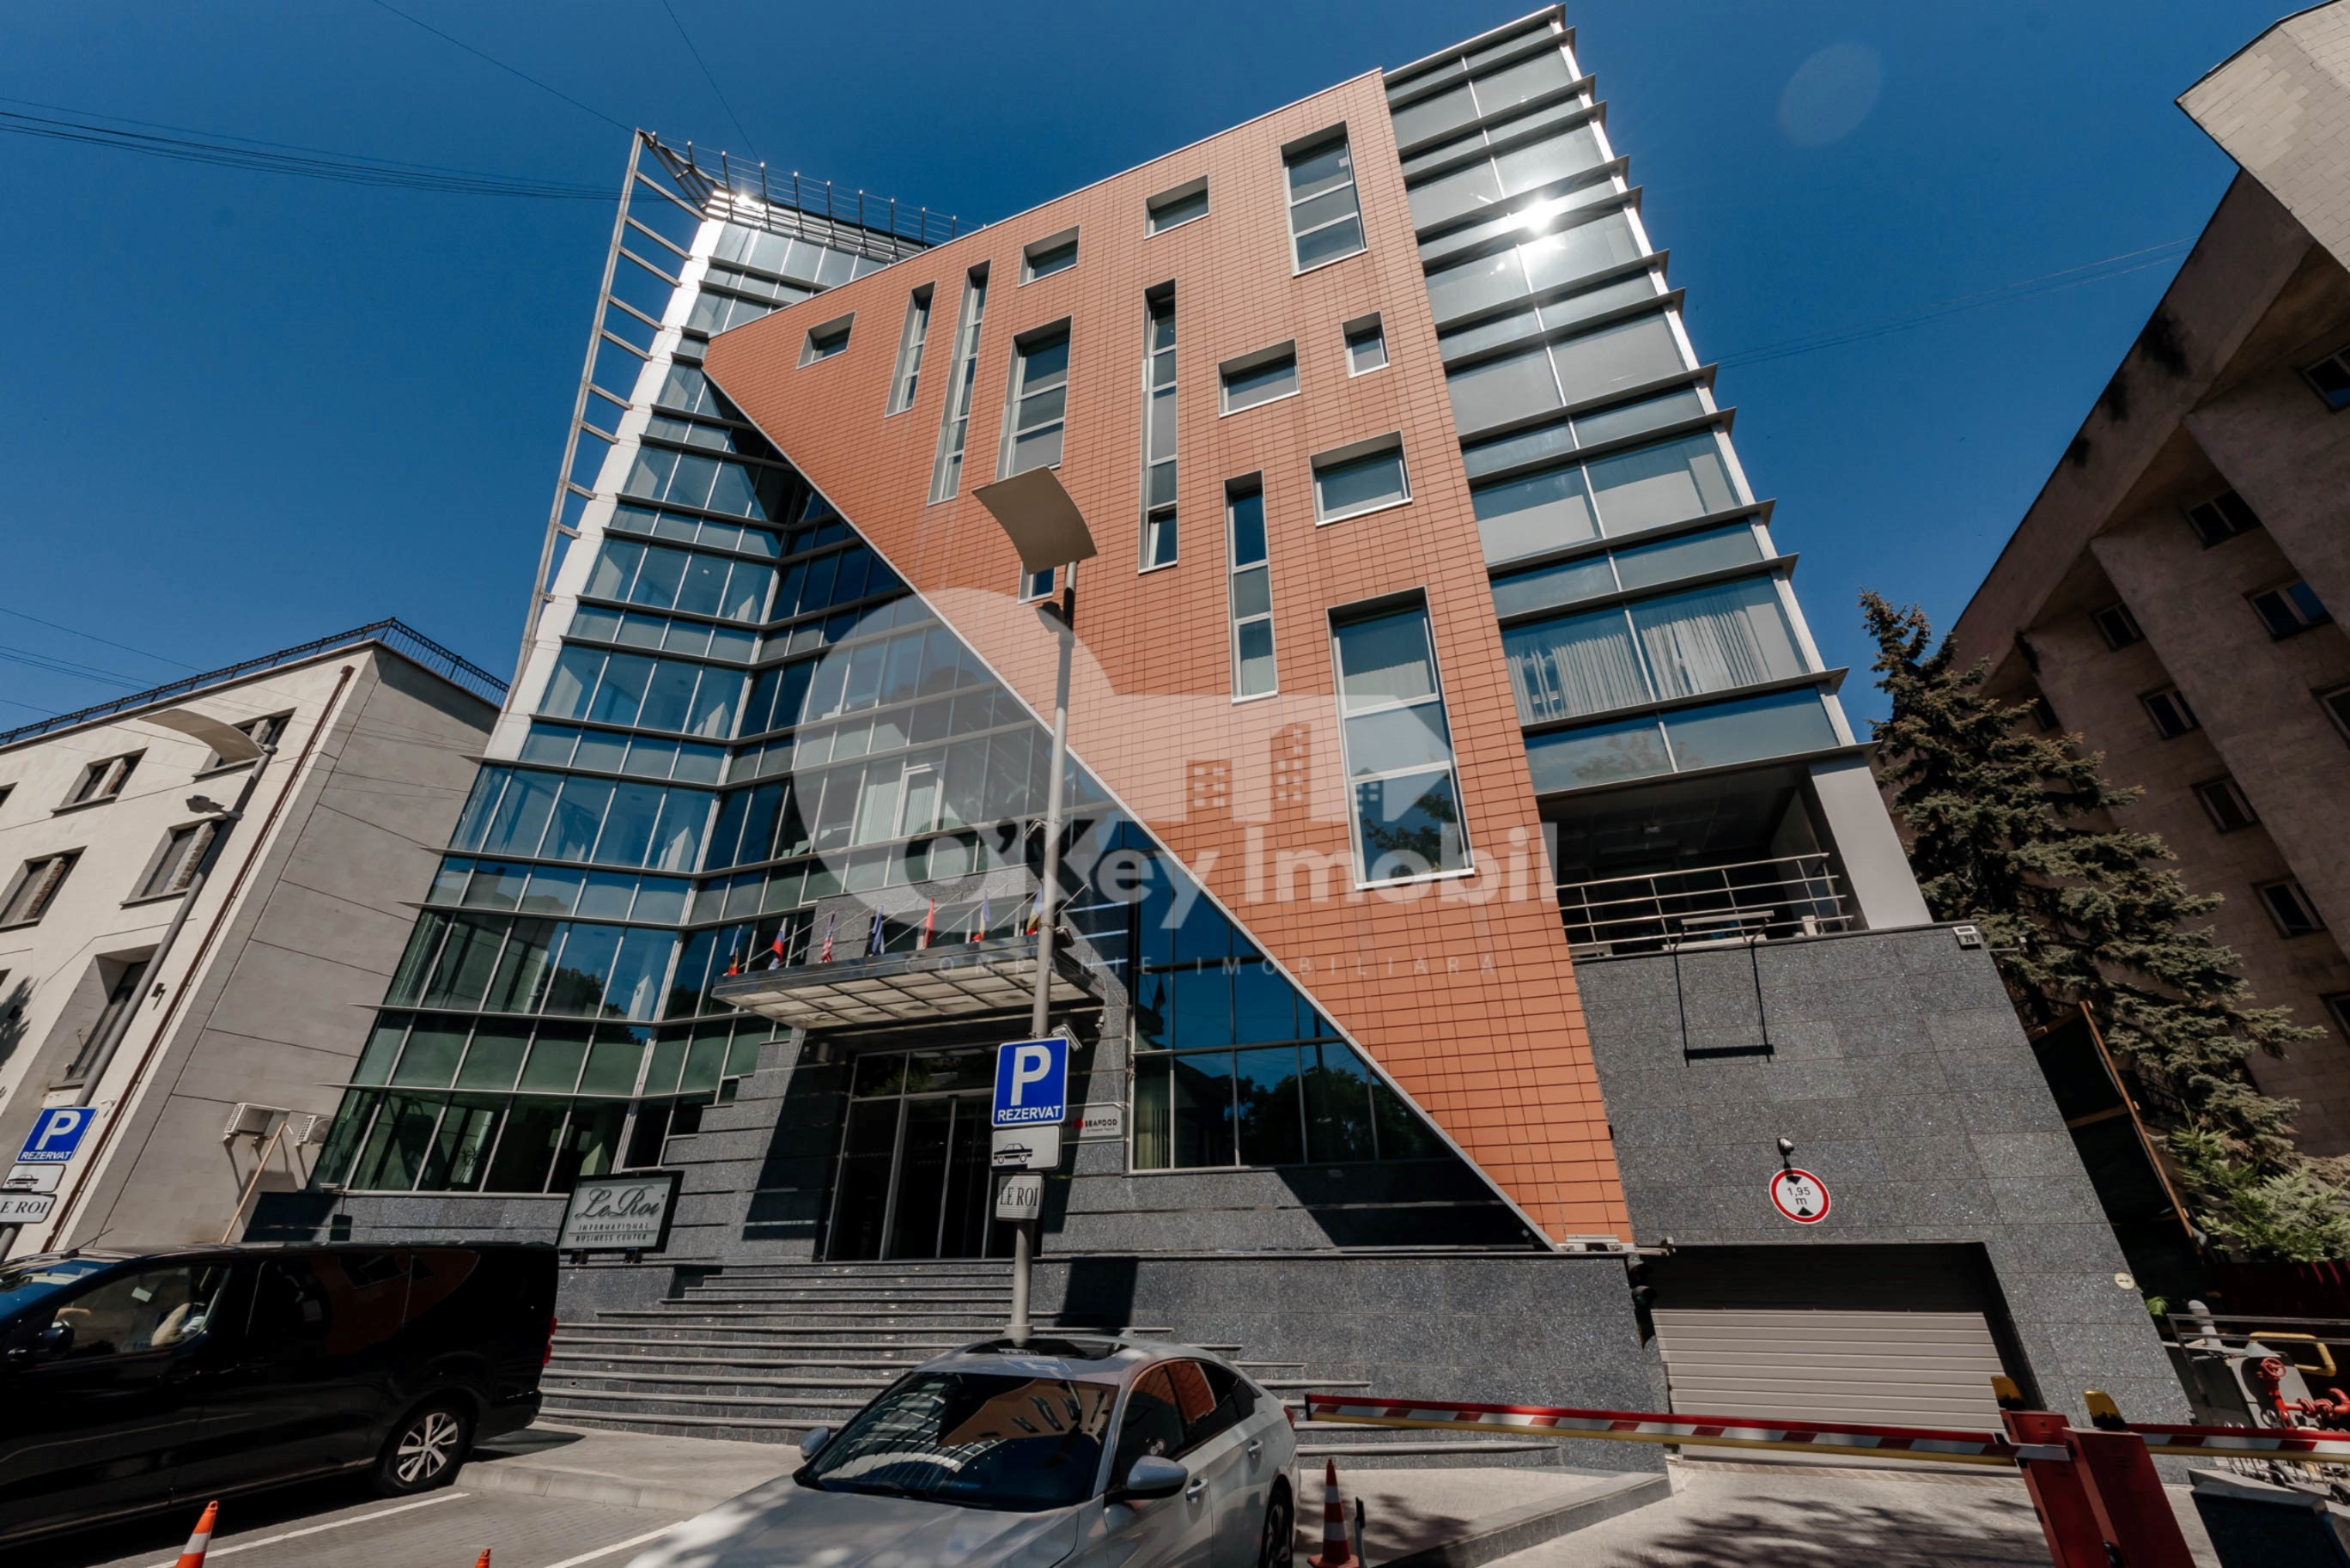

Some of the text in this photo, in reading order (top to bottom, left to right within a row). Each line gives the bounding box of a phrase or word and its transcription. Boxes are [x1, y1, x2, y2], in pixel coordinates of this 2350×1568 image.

[1010, 1045, 1052, 1106] P
[997, 1105, 1062, 1122] REZERVAT
[1085, 1119, 1117, 1127] SEAFOOD
[34, 1110, 81, 1151] P
[21, 1151, 72, 1160] REZERVAT
[1000, 1187, 1039, 1206] LE ROI
[1787, 1187, 1811, 1197] 1,95
[0, 1201, 48, 1213] E ROI
[575, 1185, 666, 1219] Le Roi
[1795, 1197, 1807, 1206] m
[579, 1222, 648, 1231] INTERNATIONAL
[575, 1234, 613, 1243] BUSINESS
